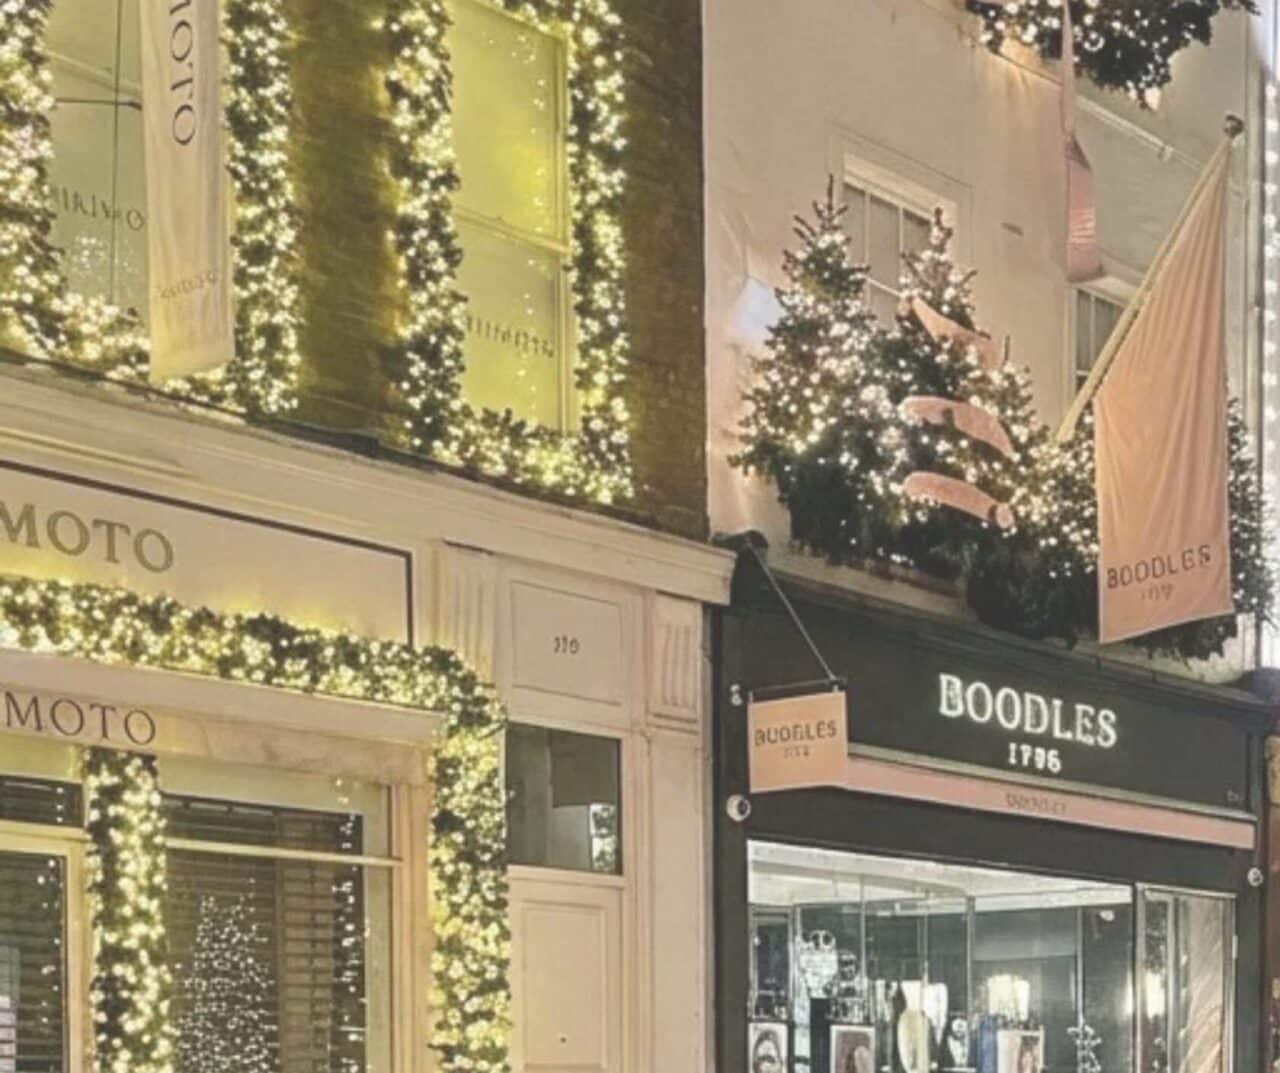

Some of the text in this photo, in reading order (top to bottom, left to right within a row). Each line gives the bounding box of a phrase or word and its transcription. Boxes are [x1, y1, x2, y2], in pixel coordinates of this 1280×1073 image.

[169, 0, 196, 146] OTO
[5, 690, 156, 746] MOTO
[938, 672, 1117, 748] BOODLES
